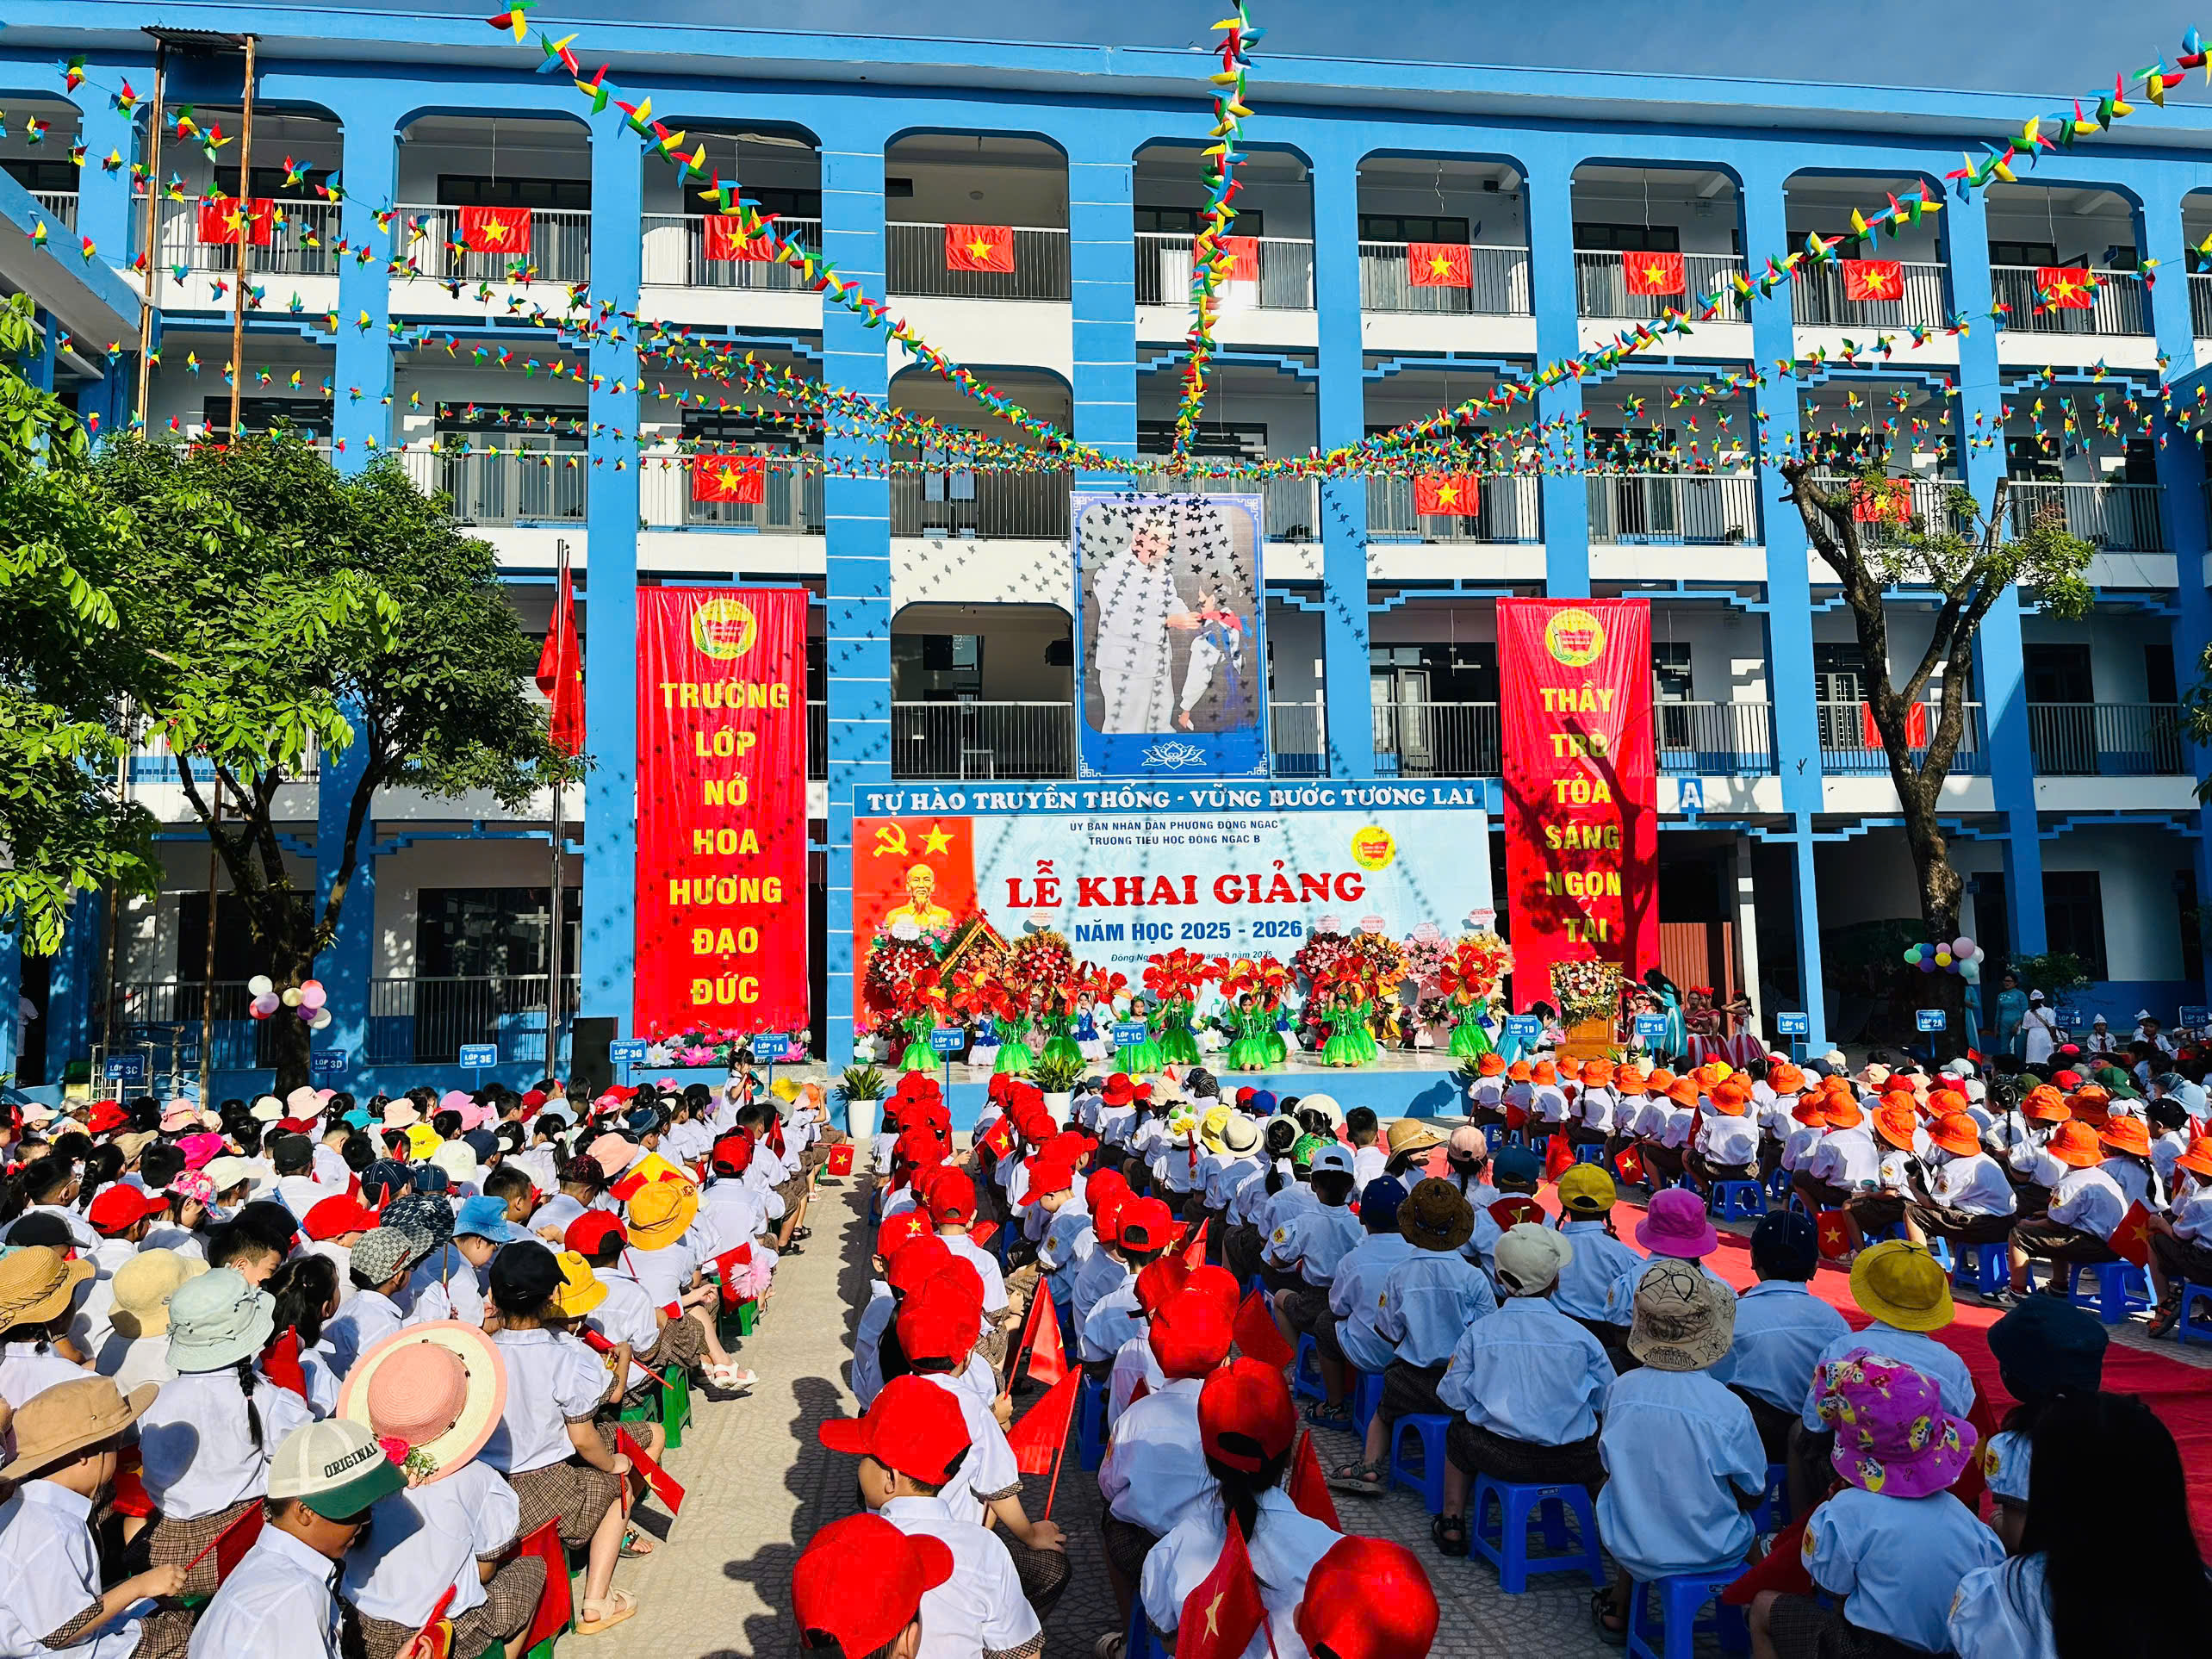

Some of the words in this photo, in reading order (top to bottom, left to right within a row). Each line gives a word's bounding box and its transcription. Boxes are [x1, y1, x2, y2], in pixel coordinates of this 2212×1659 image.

[660, 676, 790, 709] TRƯỜNG
[1539, 680, 1614, 712] THẦY
[695, 724, 756, 757] LỚP
[1550, 728, 1608, 758] TRÒ
[704, 772, 749, 806] NỞ
[867, 791, 904, 817] TỰ
[910, 786, 966, 811] HÀO
[972, 782, 1077, 810] TRUYỀN
[1083, 777, 1171, 809] THỐNG
[1190, 784, 1261, 808] VỮNG
[1269, 782, 1335, 807] BƯỚC
[1341, 787, 1426, 806] TƯƠNG
[1432, 788, 1475, 805] LAI
[1552, 771, 1612, 804] TỎA
[1681, 782, 1703, 808] A
[1087, 822, 1109, 831] BAN
[1253, 835, 1261, 843] B
[1544, 819, 1620, 850] SÁNG
[693, 828, 760, 854] HOA
[669, 875, 782, 905] HƯƠNG
[1005, 860, 1063, 908] LỄ
[1077, 874, 1198, 907] KHAI
[1214, 860, 1366, 904] GIẢNG
[1544, 871, 1622, 902] NGỌN
[1075, 919, 1125, 942] NĂM
[1132, 923, 1173, 944] HỌC
[1181, 922, 1231, 940] 2025
[1252, 920, 1302, 938] 2026
[1562, 912, 1607, 942] TÀI
[692, 926, 759, 960] ĐẠO
[690, 971, 759, 1005] ĐỨC
[1524, 1025, 1535, 1034] 1D
[1653, 1023, 1664, 1032] 1E
[1794, 1022, 1805, 1030] 1G
[1932, 1019, 1943, 1028] 2A
[2196, 1015, 2206, 1023] 2C
[773, 1044, 784, 1053] 1A
[1130, 1032, 1142, 1041] 1C
[331, 1059, 343, 1069] 3D
[479, 1054, 492, 1064] 3E
[630, 1049, 643, 1058] 3G
[125, 1066, 138, 1075] 3C
[324, 1442, 378, 1478] ORIGINAL
